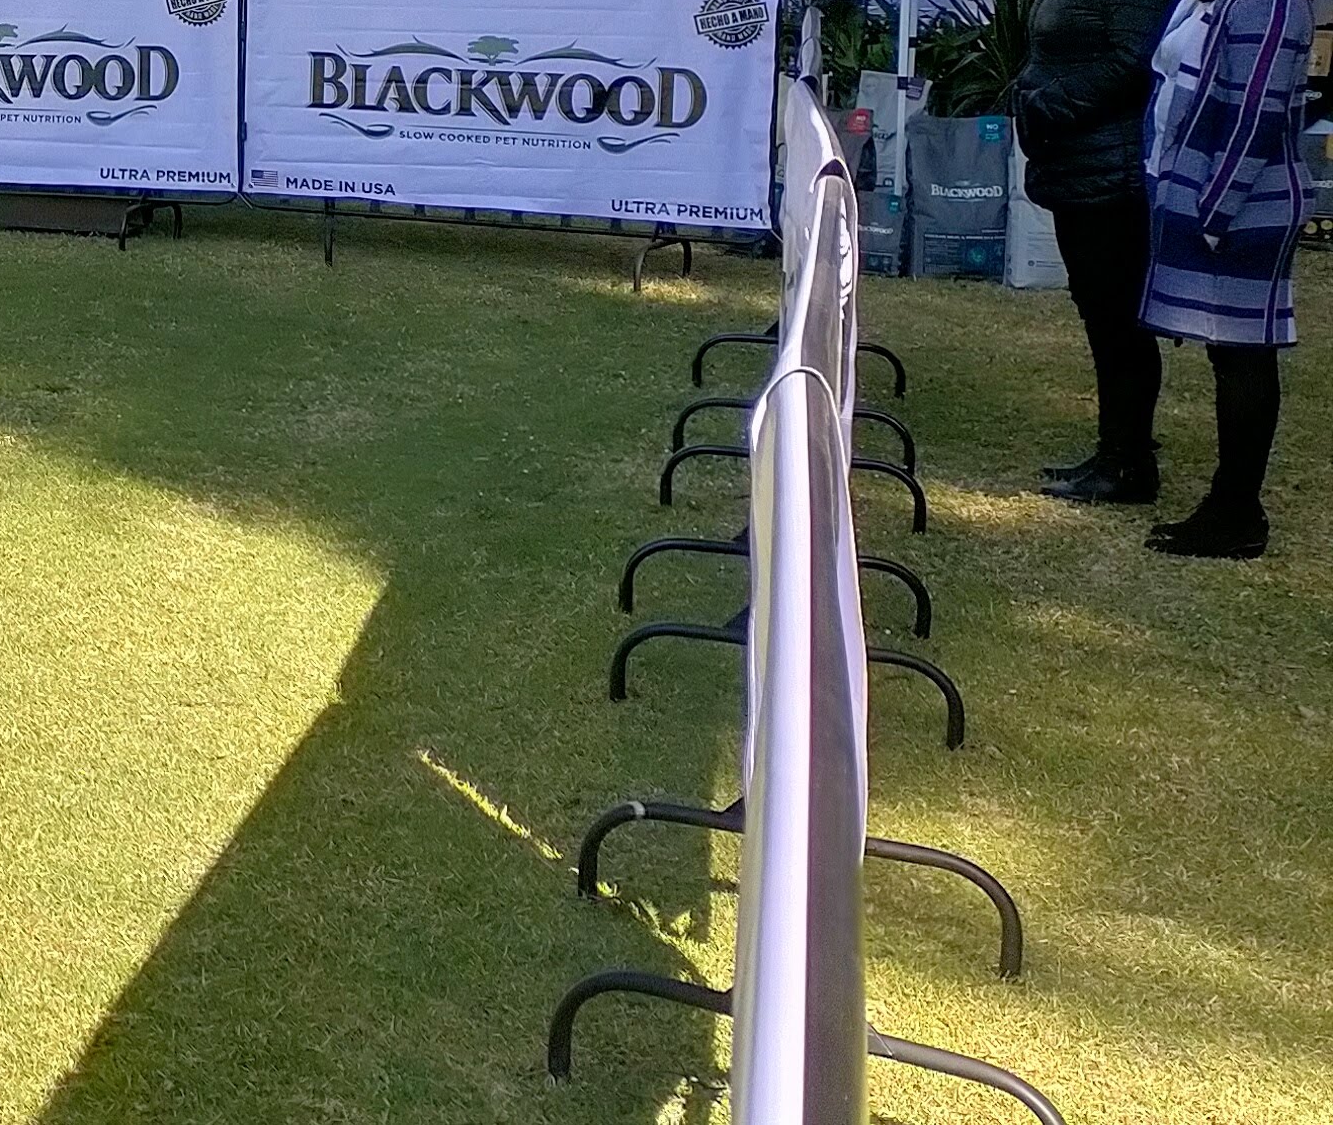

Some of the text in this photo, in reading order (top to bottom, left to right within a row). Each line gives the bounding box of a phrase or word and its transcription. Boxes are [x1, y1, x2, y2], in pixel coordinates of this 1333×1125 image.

[699, 6, 764, 30] HECHO A MANO
[307, 51, 707, 129] BLACKWOOD
[0, 114, 20, 122] PET
[22, 114, 82, 124] NUTRITION
[399, 130, 591, 150] SLOW COOKED PET NUTRITION
[100, 167, 231, 184] ULTRA PREMIUM
[286, 177, 396, 196] MADE IN USA
[931, 183, 1004, 198] BLACKWOOD
[611, 199, 763, 221] ULTRA PREMIUM
